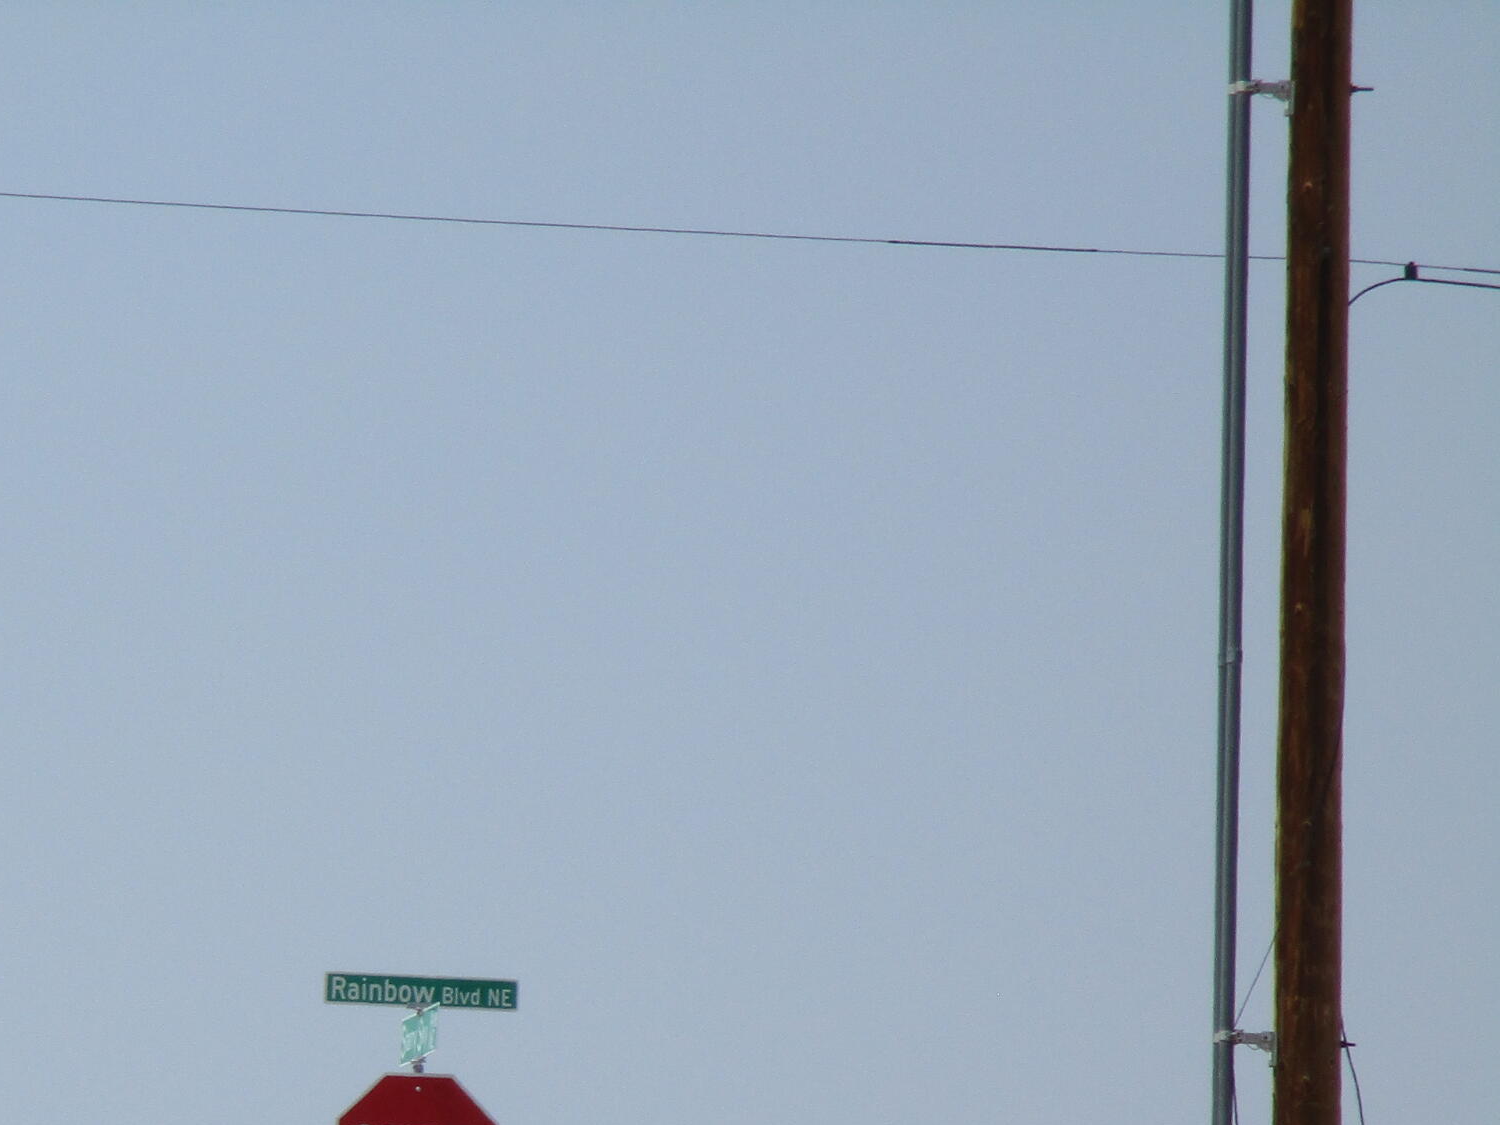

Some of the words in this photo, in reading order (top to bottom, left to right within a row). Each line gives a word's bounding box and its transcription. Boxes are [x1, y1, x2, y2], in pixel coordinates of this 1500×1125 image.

[331, 976, 435, 1002] Rainbow
[442, 987, 480, 1006] Blvd
[488, 988, 512, 1007] NE
